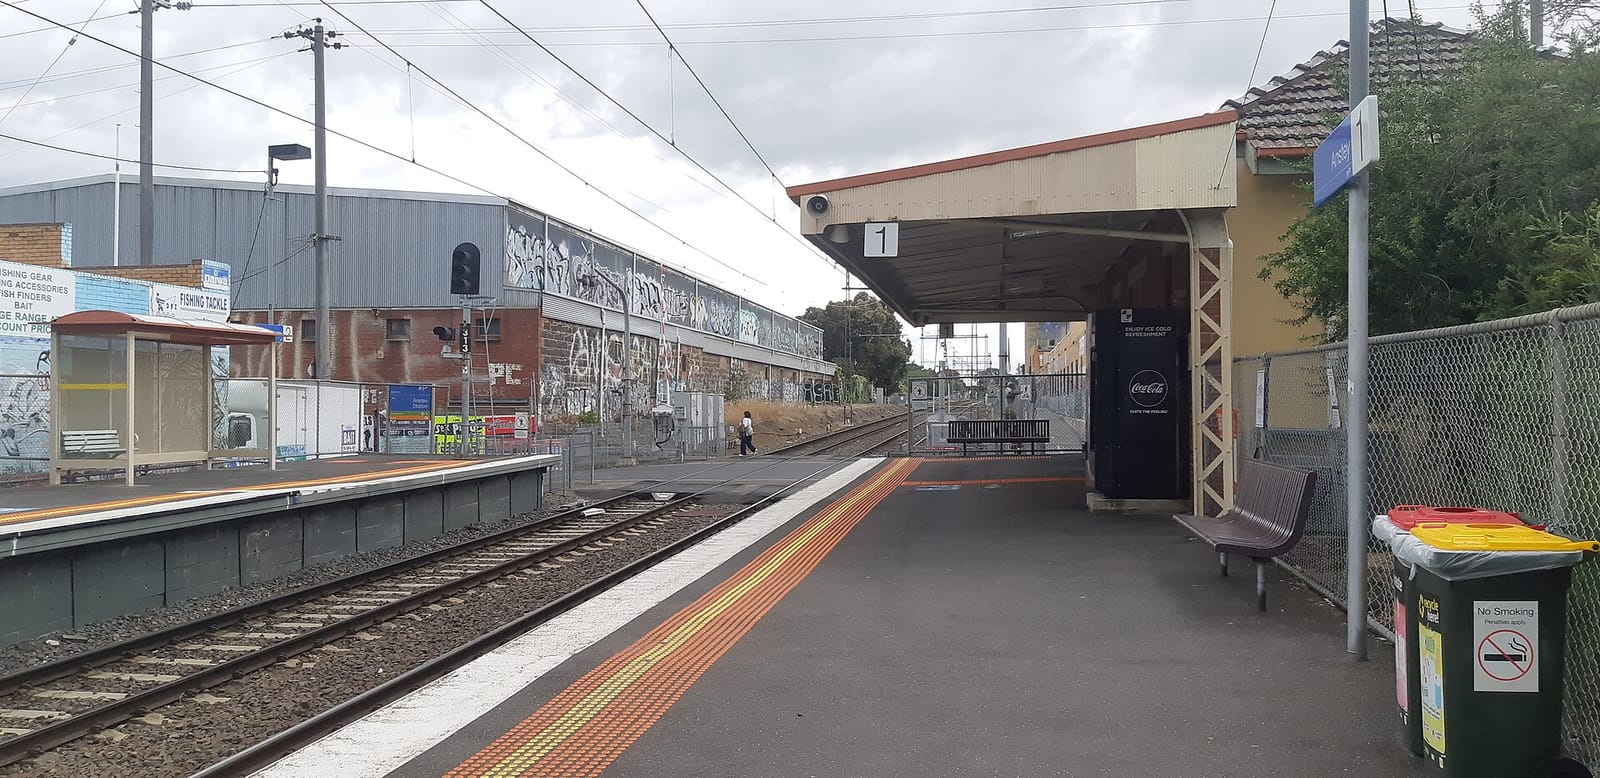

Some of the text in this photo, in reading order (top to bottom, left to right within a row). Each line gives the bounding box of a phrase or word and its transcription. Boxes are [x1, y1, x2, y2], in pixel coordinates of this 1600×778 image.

[1356, 110, 1363, 161] 1
[875, 226, 886, 254] 1
[30, 273, 52, 282] GEAR
[15, 281, 68, 294] ACCESSORIES
[17, 291, 51, 302] FINDERS
[180, 293, 205, 308] FISHING
[206, 296, 228, 311] TACKLE
[14, 301, 33, 310] BAIT
[15, 312, 47, 322] RANGE
[1477, 607, 1534, 618] No Smoking
